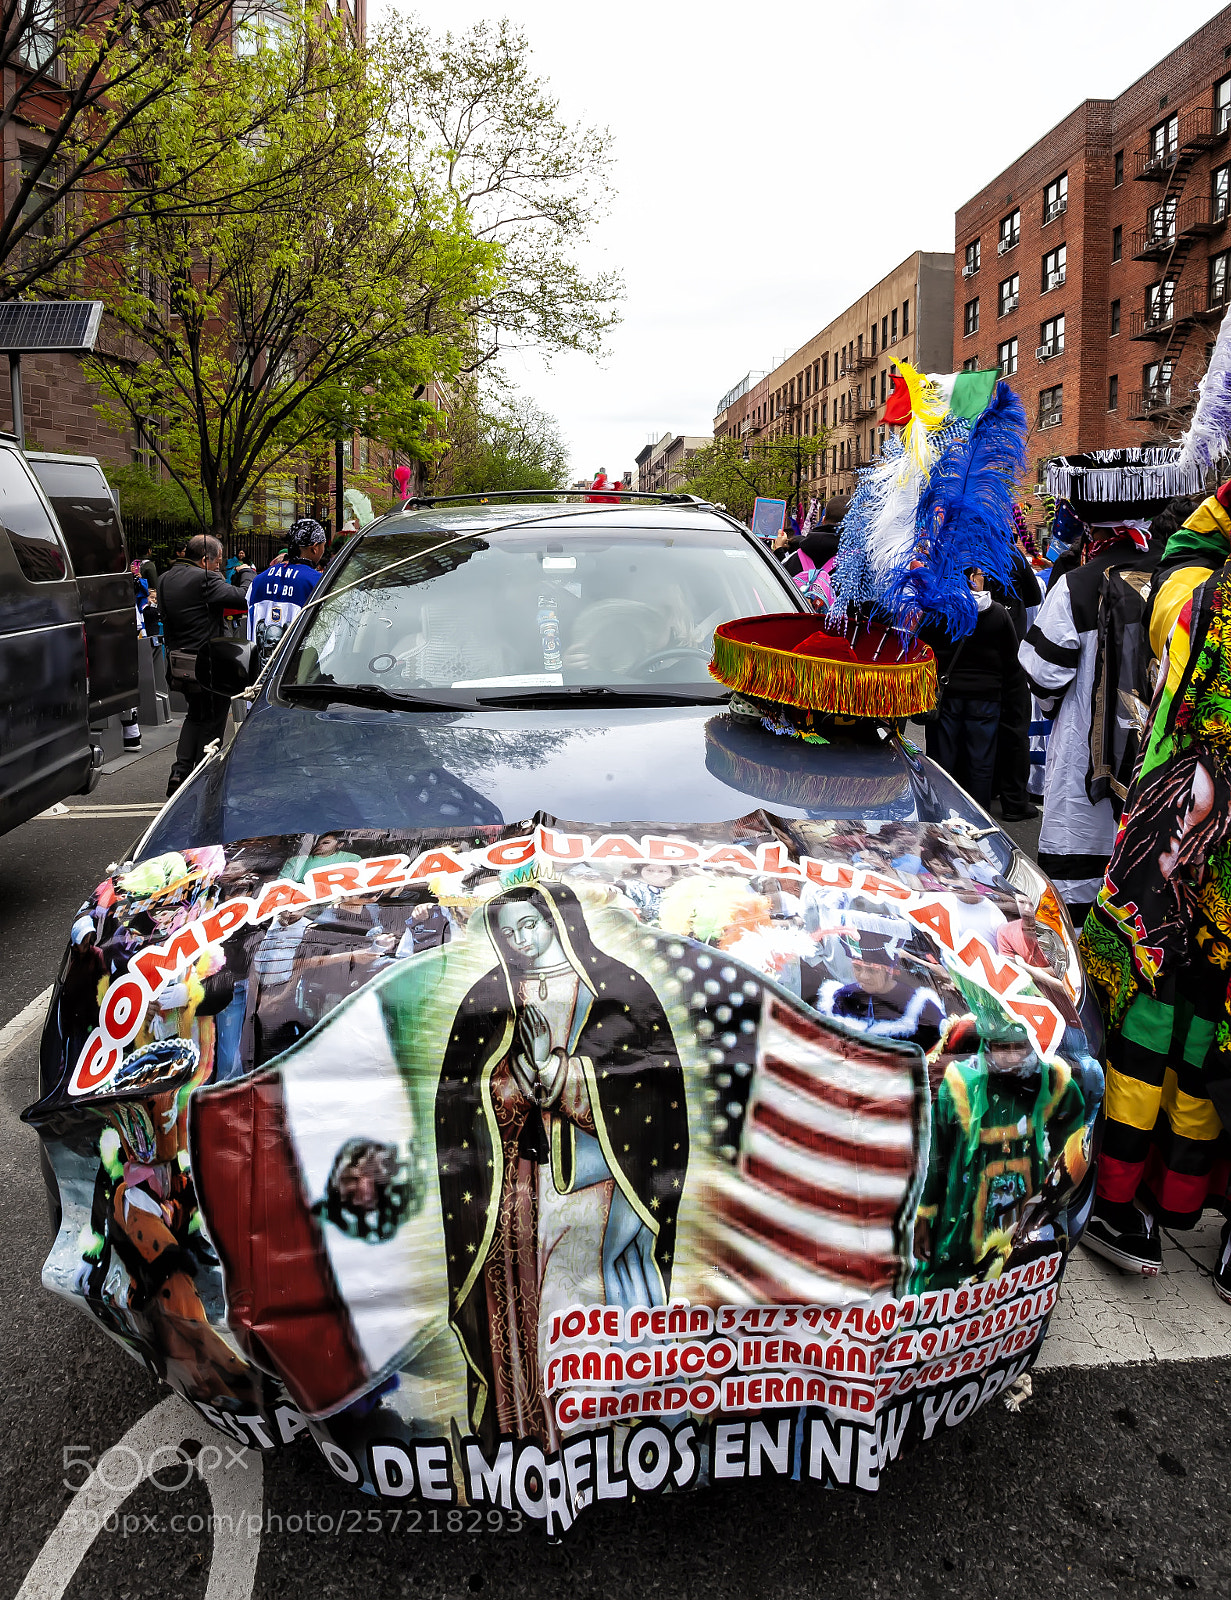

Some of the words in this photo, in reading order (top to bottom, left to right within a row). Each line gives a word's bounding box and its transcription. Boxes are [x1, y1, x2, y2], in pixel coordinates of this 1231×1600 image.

[267, 566, 299, 579] DANI
[76, 852, 464, 1091] COMPARZA
[487, 829, 1065, 1055] GUADALUPANA
[546, 1342, 732, 1391] FRANCISCO
[921, 1288, 1055, 1356] 9178227013
[549, 1308, 619, 1345] JOSE
[630, 1302, 709, 1337] PEÑA
[720, 1300, 915, 1336] 3473994604
[922, 1256, 1058, 1320] 7183667423
[558, 1386, 717, 1424] GERARDO
[725, 1375, 897, 1413] HERNANDZ
[898, 1324, 1039, 1391] 6465251425
[194, 1400, 360, 1483] ESTAO
[371, 1445, 452, 1500] DE
[466, 1425, 696, 1535] MORELOS
[714, 1418, 791, 1478] EN
[809, 1401, 912, 1491] NEW
